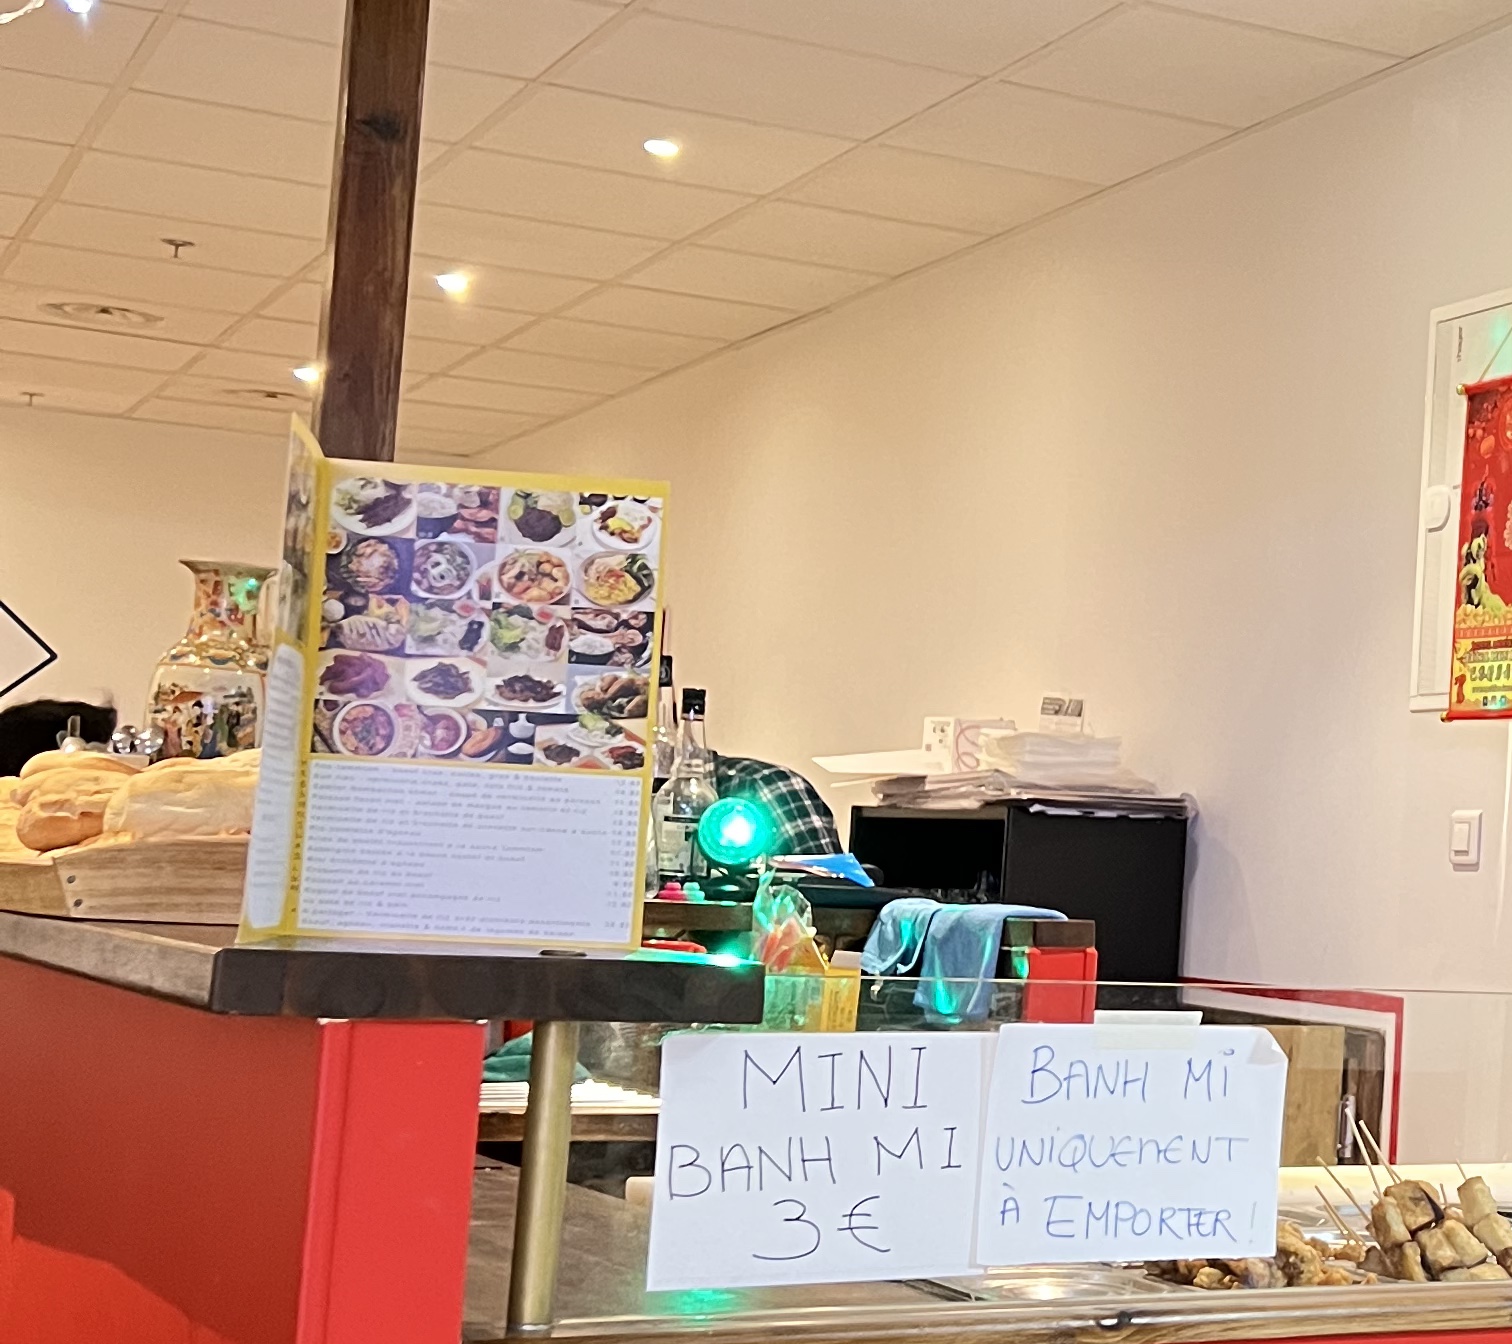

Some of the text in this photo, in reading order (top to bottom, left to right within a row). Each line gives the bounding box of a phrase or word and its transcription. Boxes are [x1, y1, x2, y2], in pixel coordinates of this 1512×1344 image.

[743, 1045, 927, 1113] MINI
[1021, 1044, 1149, 1105] BANH
[668, 1127, 962, 1200] BANH MI
